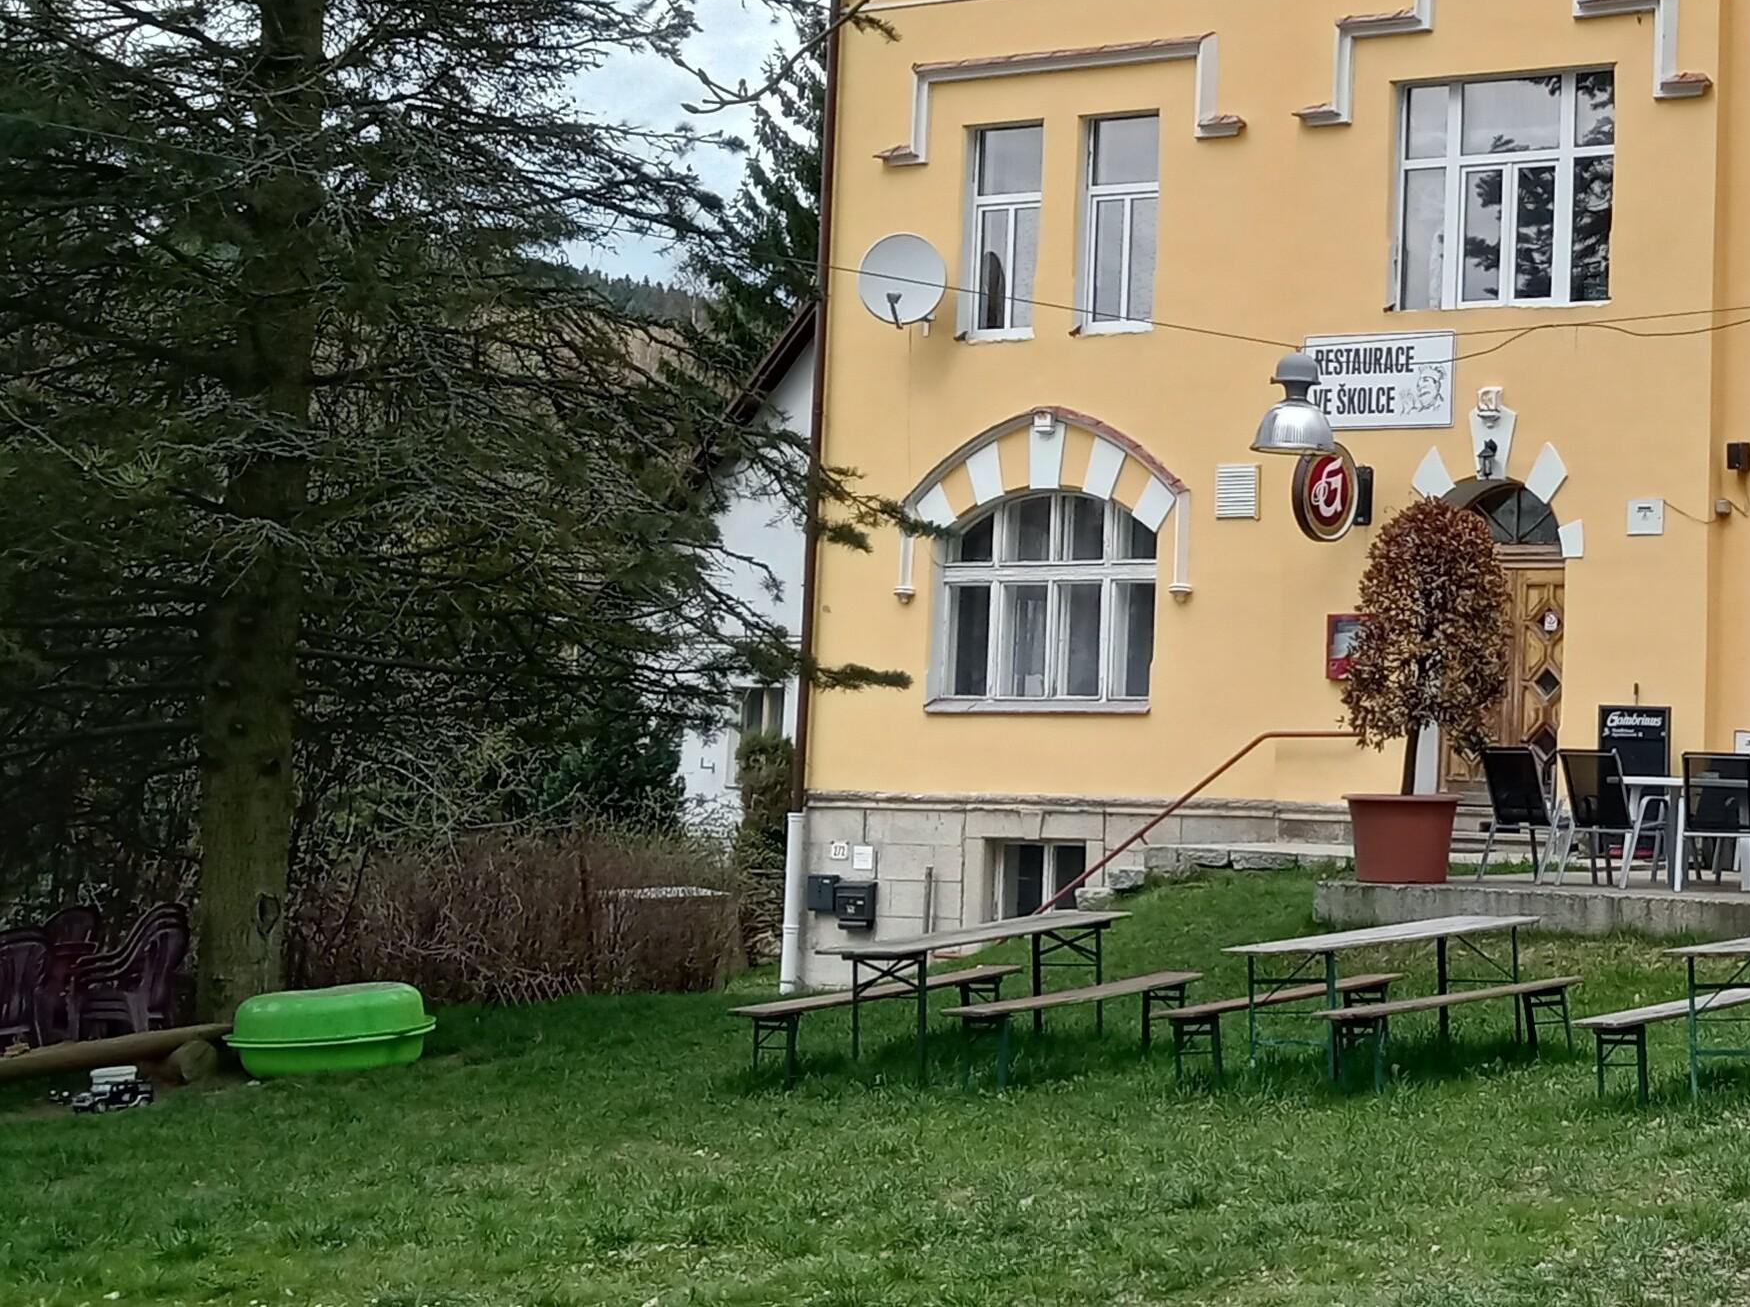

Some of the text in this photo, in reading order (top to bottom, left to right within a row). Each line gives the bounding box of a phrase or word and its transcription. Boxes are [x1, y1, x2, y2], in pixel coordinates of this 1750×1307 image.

[1314, 345, 1415, 376] RESTAURACE
[1313, 383, 1396, 416] VE ŠKOLCE
[1606, 711, 1663, 727] Gambrinus
